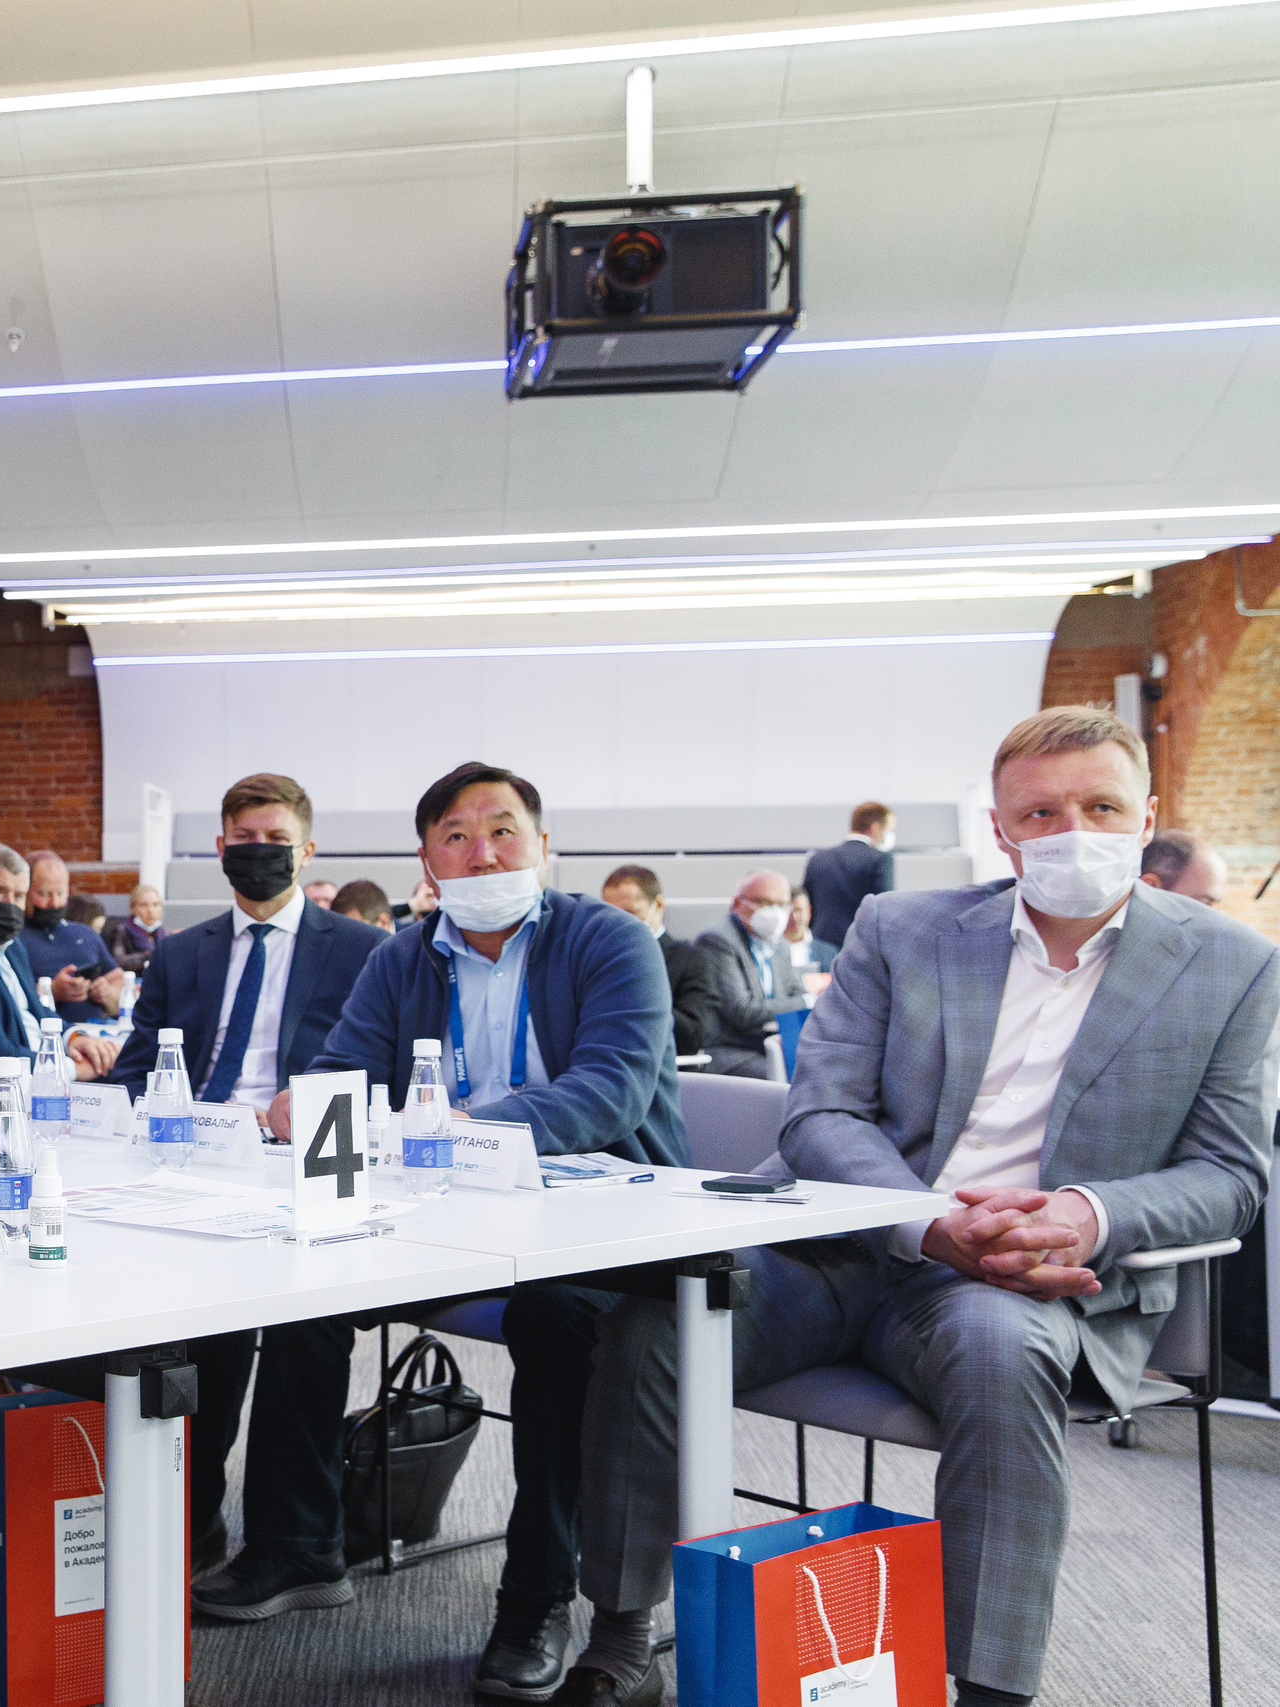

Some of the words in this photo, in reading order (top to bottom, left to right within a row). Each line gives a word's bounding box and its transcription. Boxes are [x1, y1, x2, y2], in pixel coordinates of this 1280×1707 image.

[136, 1111, 150, 1122] ВЛ
[303, 1092, 364, 1199] 4
[452, 1135, 500, 1151] ИТАНОВ
[64, 1529, 95, 1542] Добро
